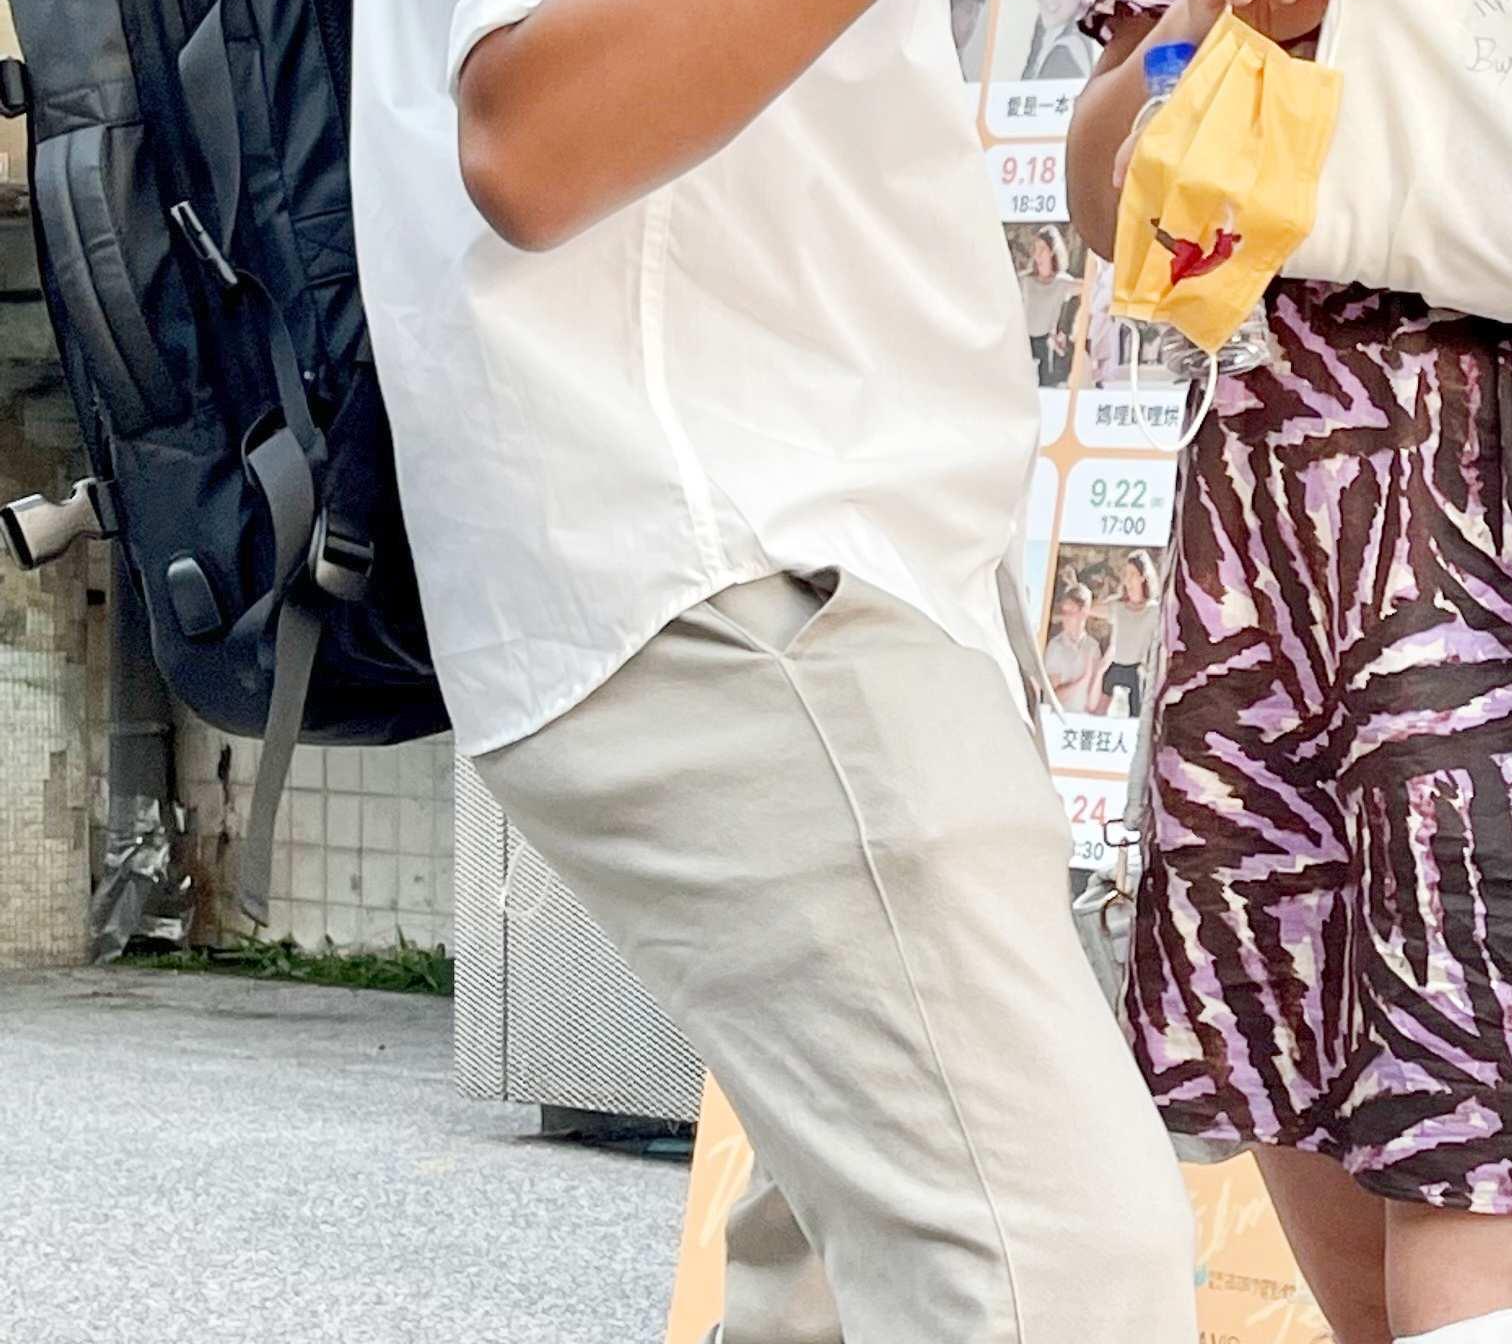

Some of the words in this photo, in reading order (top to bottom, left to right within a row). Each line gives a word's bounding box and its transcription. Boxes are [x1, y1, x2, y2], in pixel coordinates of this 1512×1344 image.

[1001, 156, 1057, 184] 9.18
[1012, 195, 1056, 213] 18:30
[1090, 478, 1147, 508] 9.22
[1101, 515, 1146, 535] 17:00
[1062, 728, 1128, 754] 交響狂人
